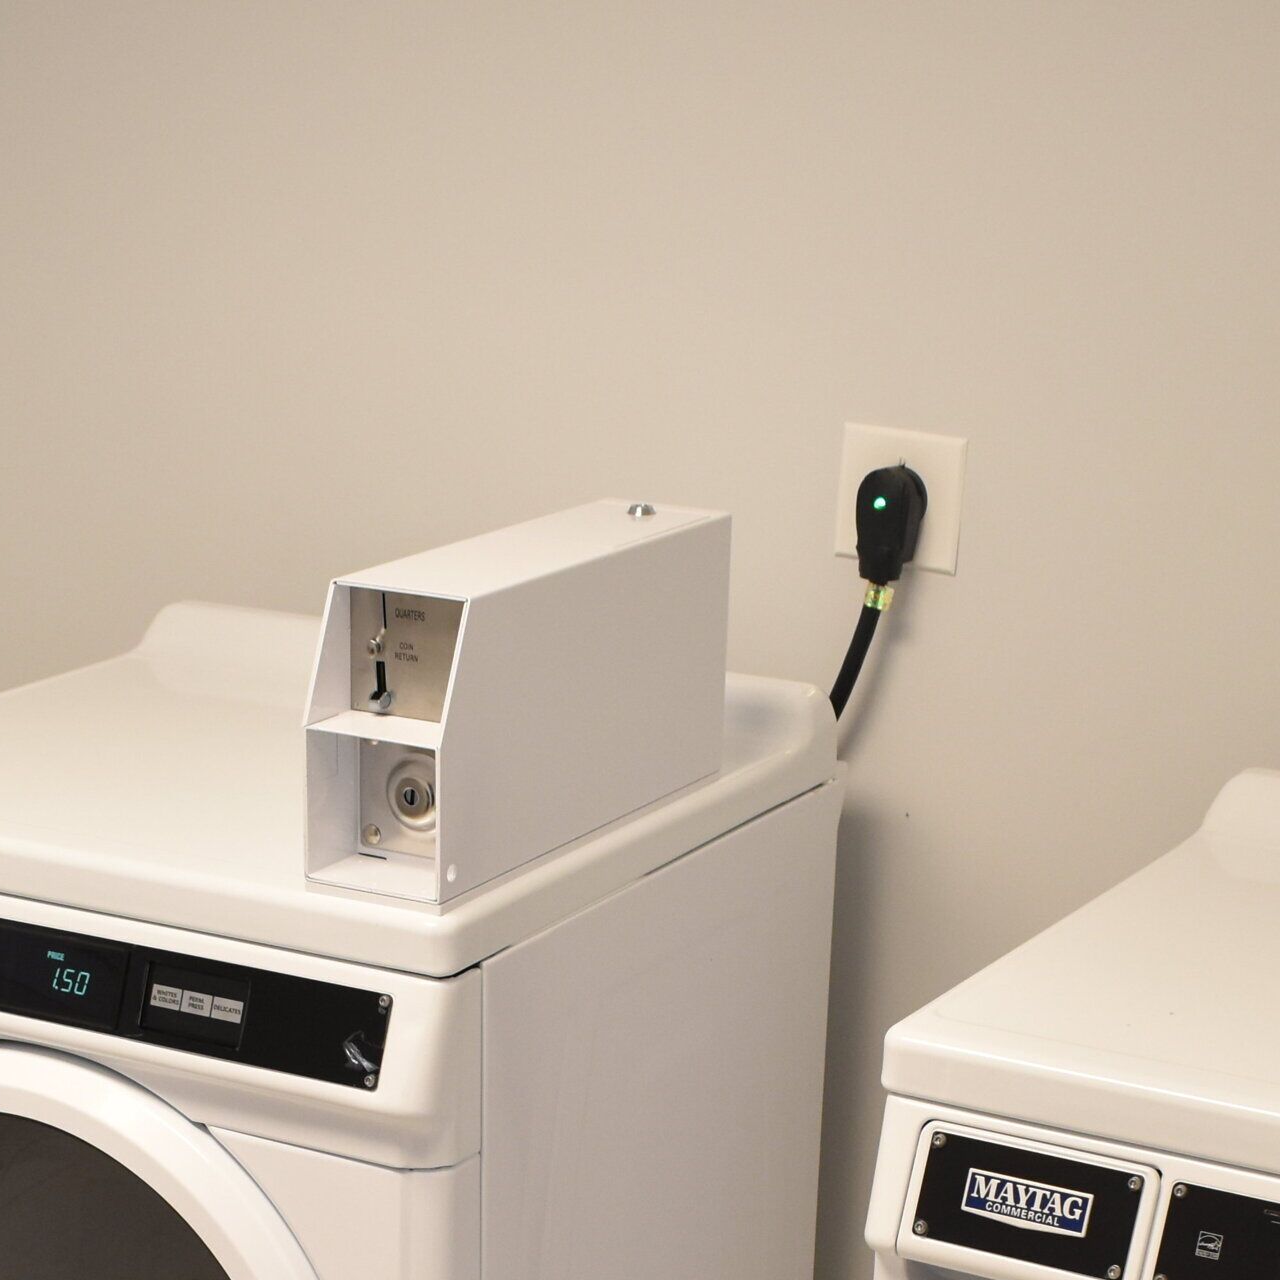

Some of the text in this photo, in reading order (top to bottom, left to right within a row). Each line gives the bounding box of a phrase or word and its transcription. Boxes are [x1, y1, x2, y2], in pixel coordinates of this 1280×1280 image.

[395, 608, 425, 621] QUARTERS
[400, 642, 413, 650] COIN
[395, 652, 418, 662] RETURN
[47, 951, 65, 961] PRICE
[52, 968, 90, 995] 1.50
[156, 989, 177, 998] WHITES
[213, 1004, 241, 1015] DELICATES
[970, 1175, 1083, 1220] MAYTAG
[985, 1201, 1060, 1226] COMMERCIAL
